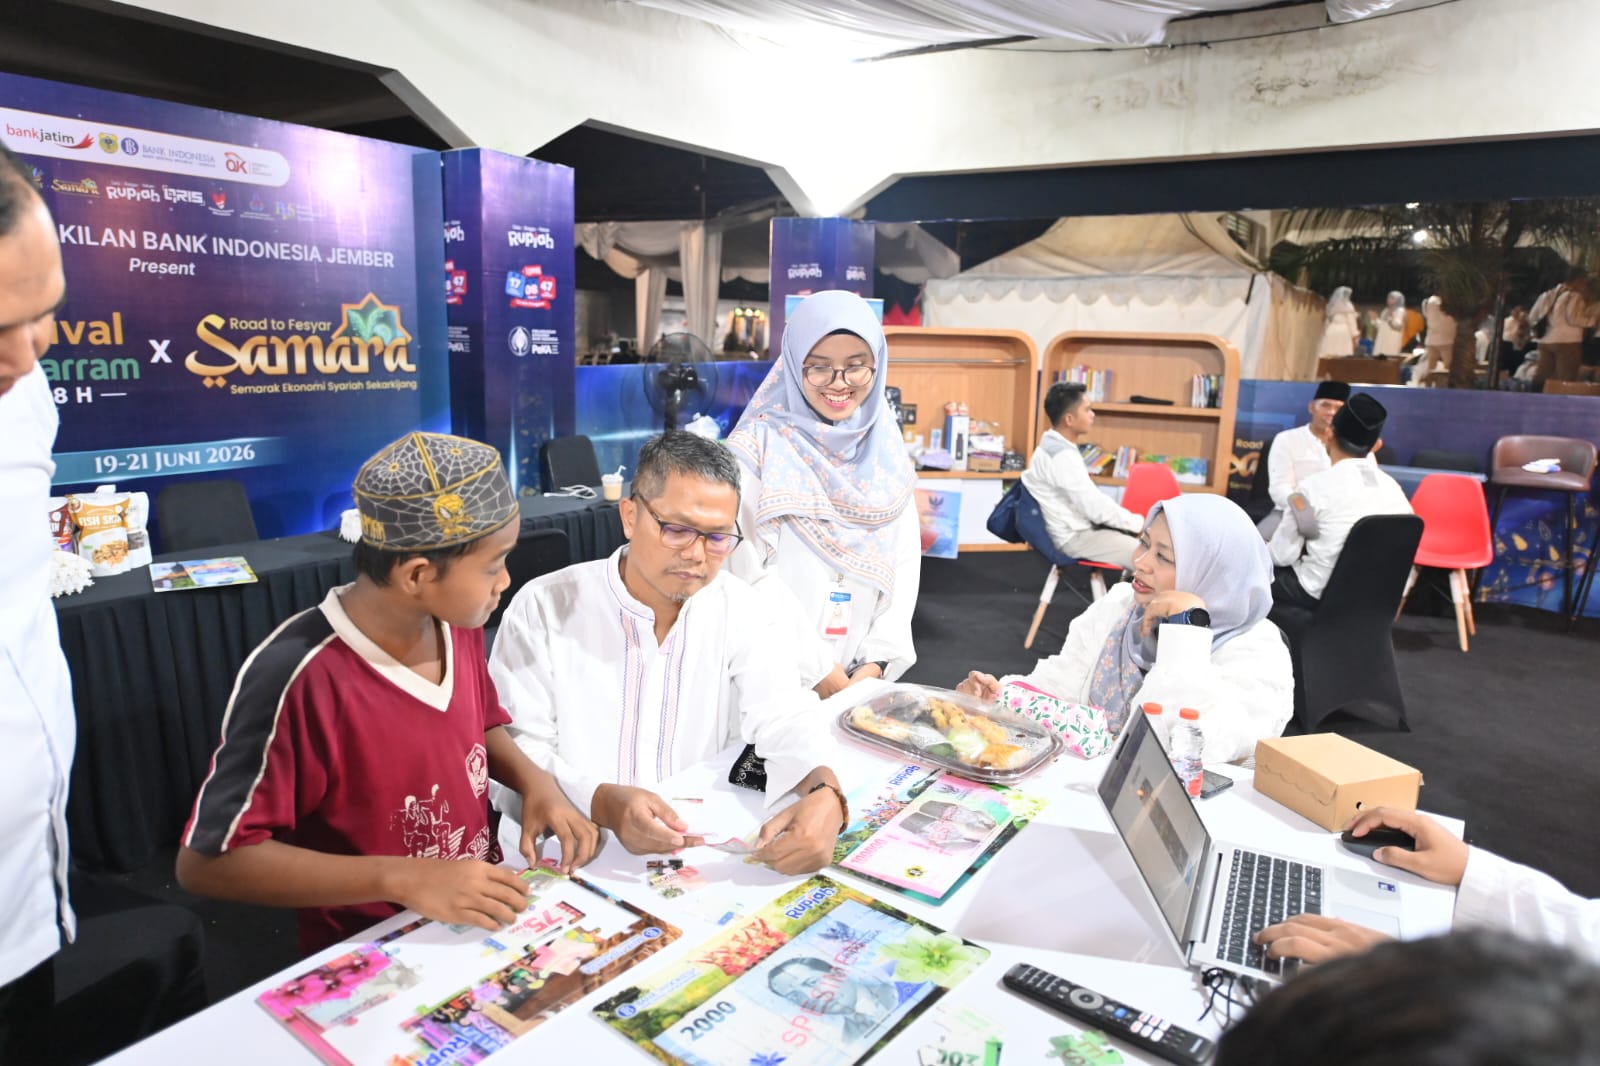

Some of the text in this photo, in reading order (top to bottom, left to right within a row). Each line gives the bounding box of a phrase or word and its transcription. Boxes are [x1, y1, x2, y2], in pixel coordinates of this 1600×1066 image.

[6, 123, 75, 144] bankjatim
[106, 185, 160, 202] Rupiah
[57, 224, 395, 268] KILAN BANK INDONESIA JEMBER
[508, 231, 554, 249] Rupiah
[129, 257, 196, 275] Present
[230, 317, 332, 334] Road to Fesyar
[185, 314, 417, 377] Samara
[76, 386, 93, 404] H
[230, 383, 280, 395] Semarak
[282, 382, 326, 393] Ekonomi
[328, 381, 364, 393] Syariah
[95, 454, 149, 474] 19-21
[206, 444, 256, 464] 2026
[785, 888, 835, 919] Rupiah
[680, 1000, 737, 1041] 2000
